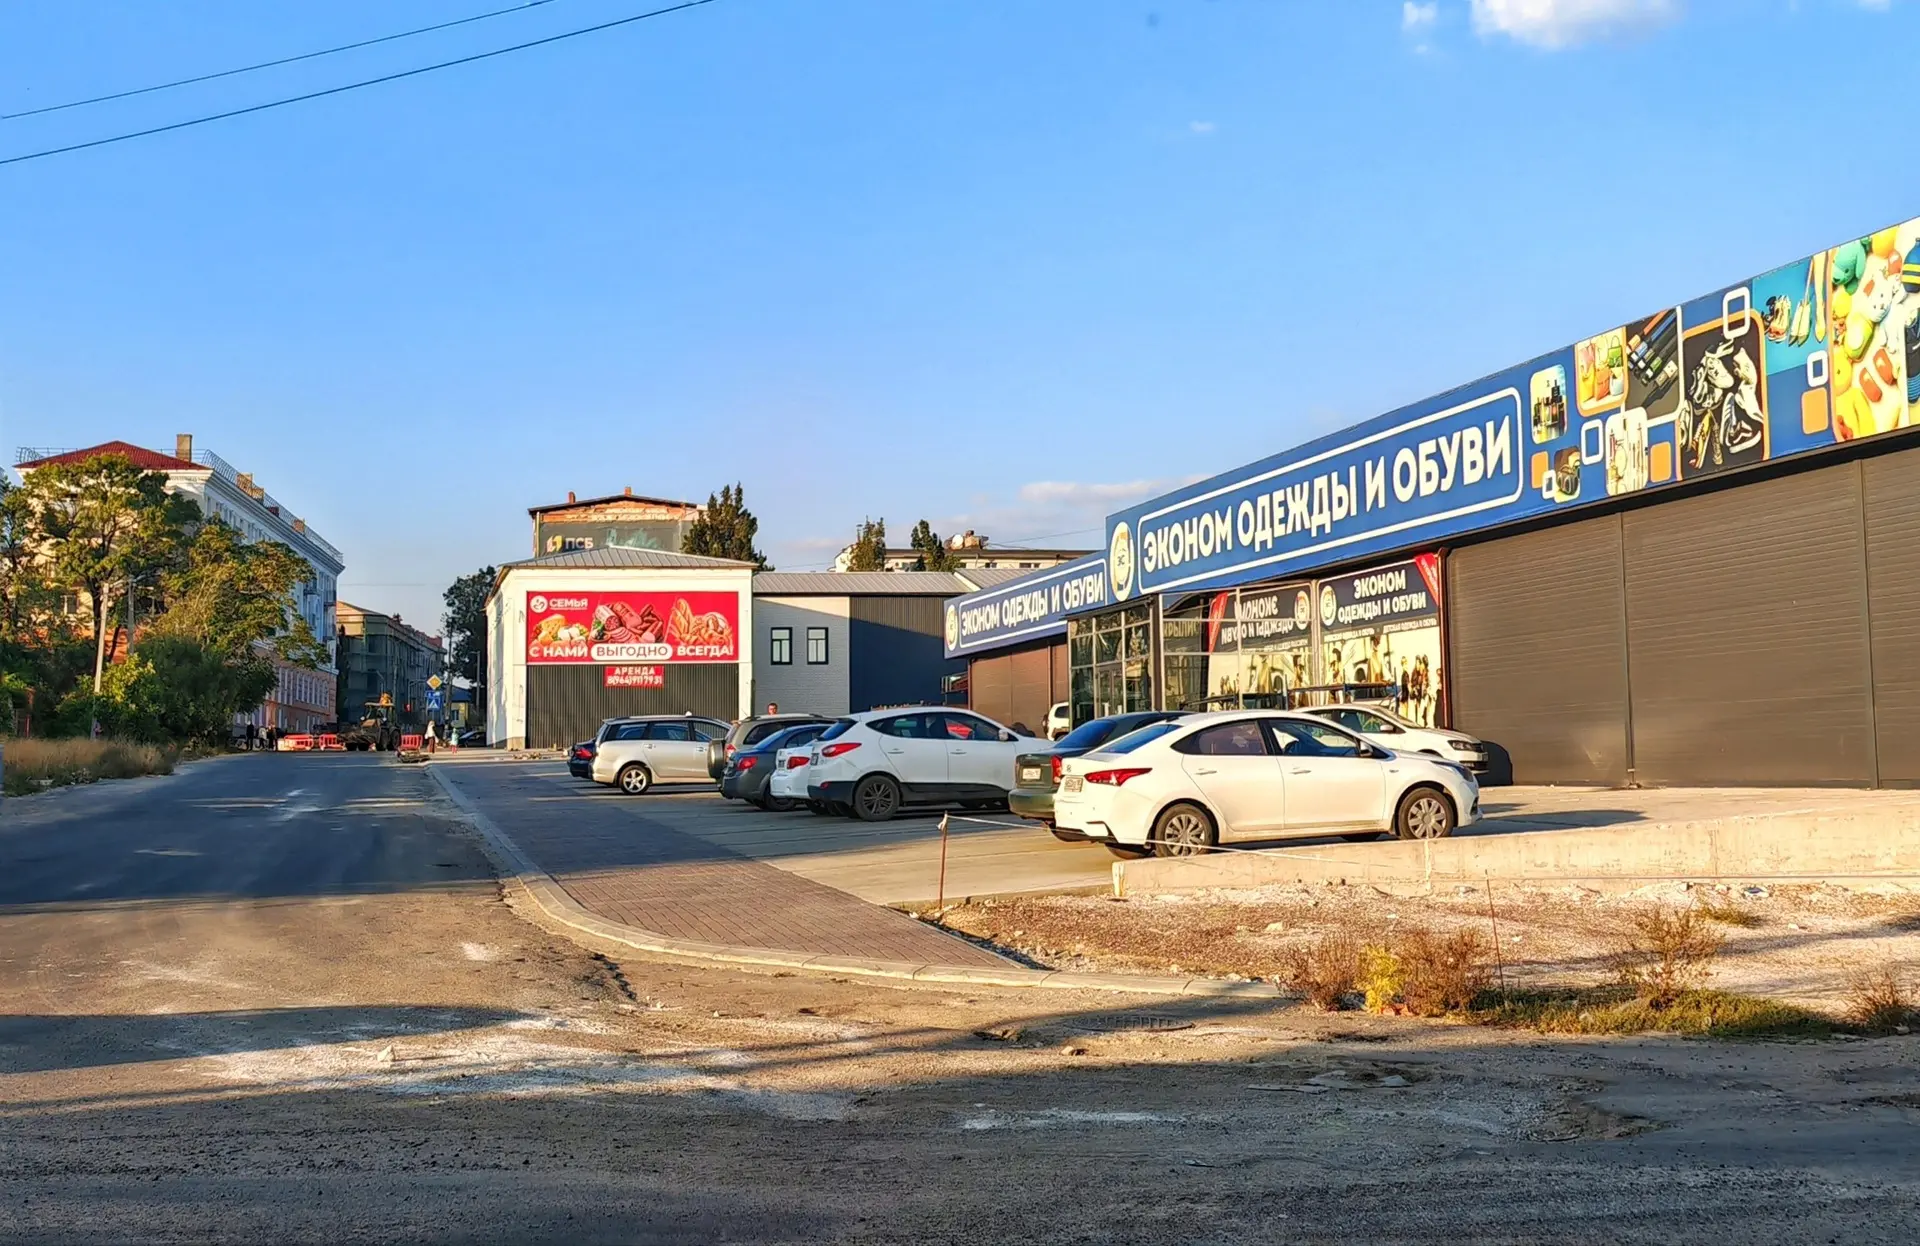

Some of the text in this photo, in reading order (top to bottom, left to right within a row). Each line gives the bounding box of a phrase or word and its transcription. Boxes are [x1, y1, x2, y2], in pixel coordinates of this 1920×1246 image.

[1143, 415, 1511, 573] ЭКОНОМ ОДЕЖДЫ И ОБУВИ
[565, 537, 594, 549] ПСБ
[1353, 569, 1407, 599] ЭКОНОМ
[549, 598, 589, 608] СЕМЬЯ
[961, 572, 1104, 636] ЭКОНОМ ОДЕЖДЫ И ОБУВИ
[1338, 591, 1427, 624] ОДЕЖДЫ И ОБУВИ
[529, 645, 734, 658] С НАМИ ВЫГОДНО ВСЕГДА!
[614, 666, 655, 675] АРЕНДА
